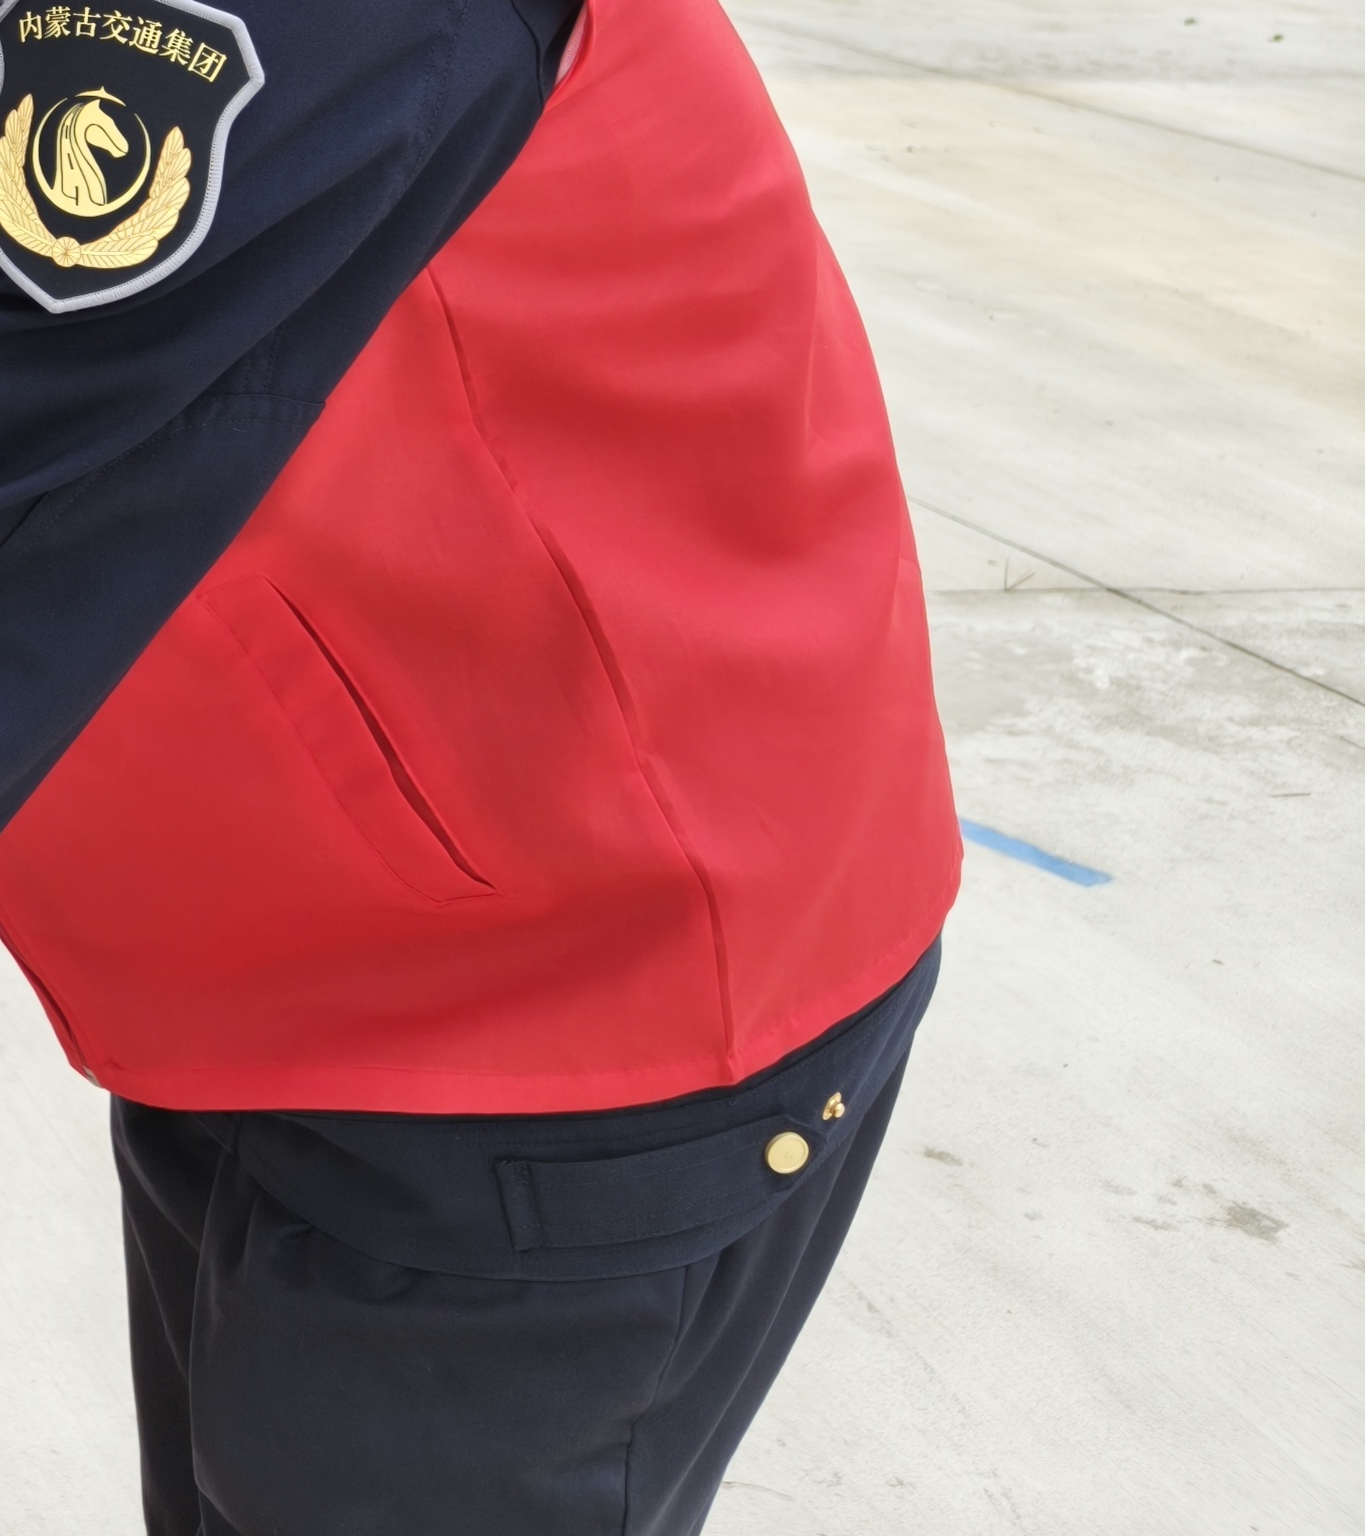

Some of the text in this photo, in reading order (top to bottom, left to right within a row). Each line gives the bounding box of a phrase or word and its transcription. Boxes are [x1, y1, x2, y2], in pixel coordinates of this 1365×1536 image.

[19, 6, 228, 83] 内蒙古交通集团
